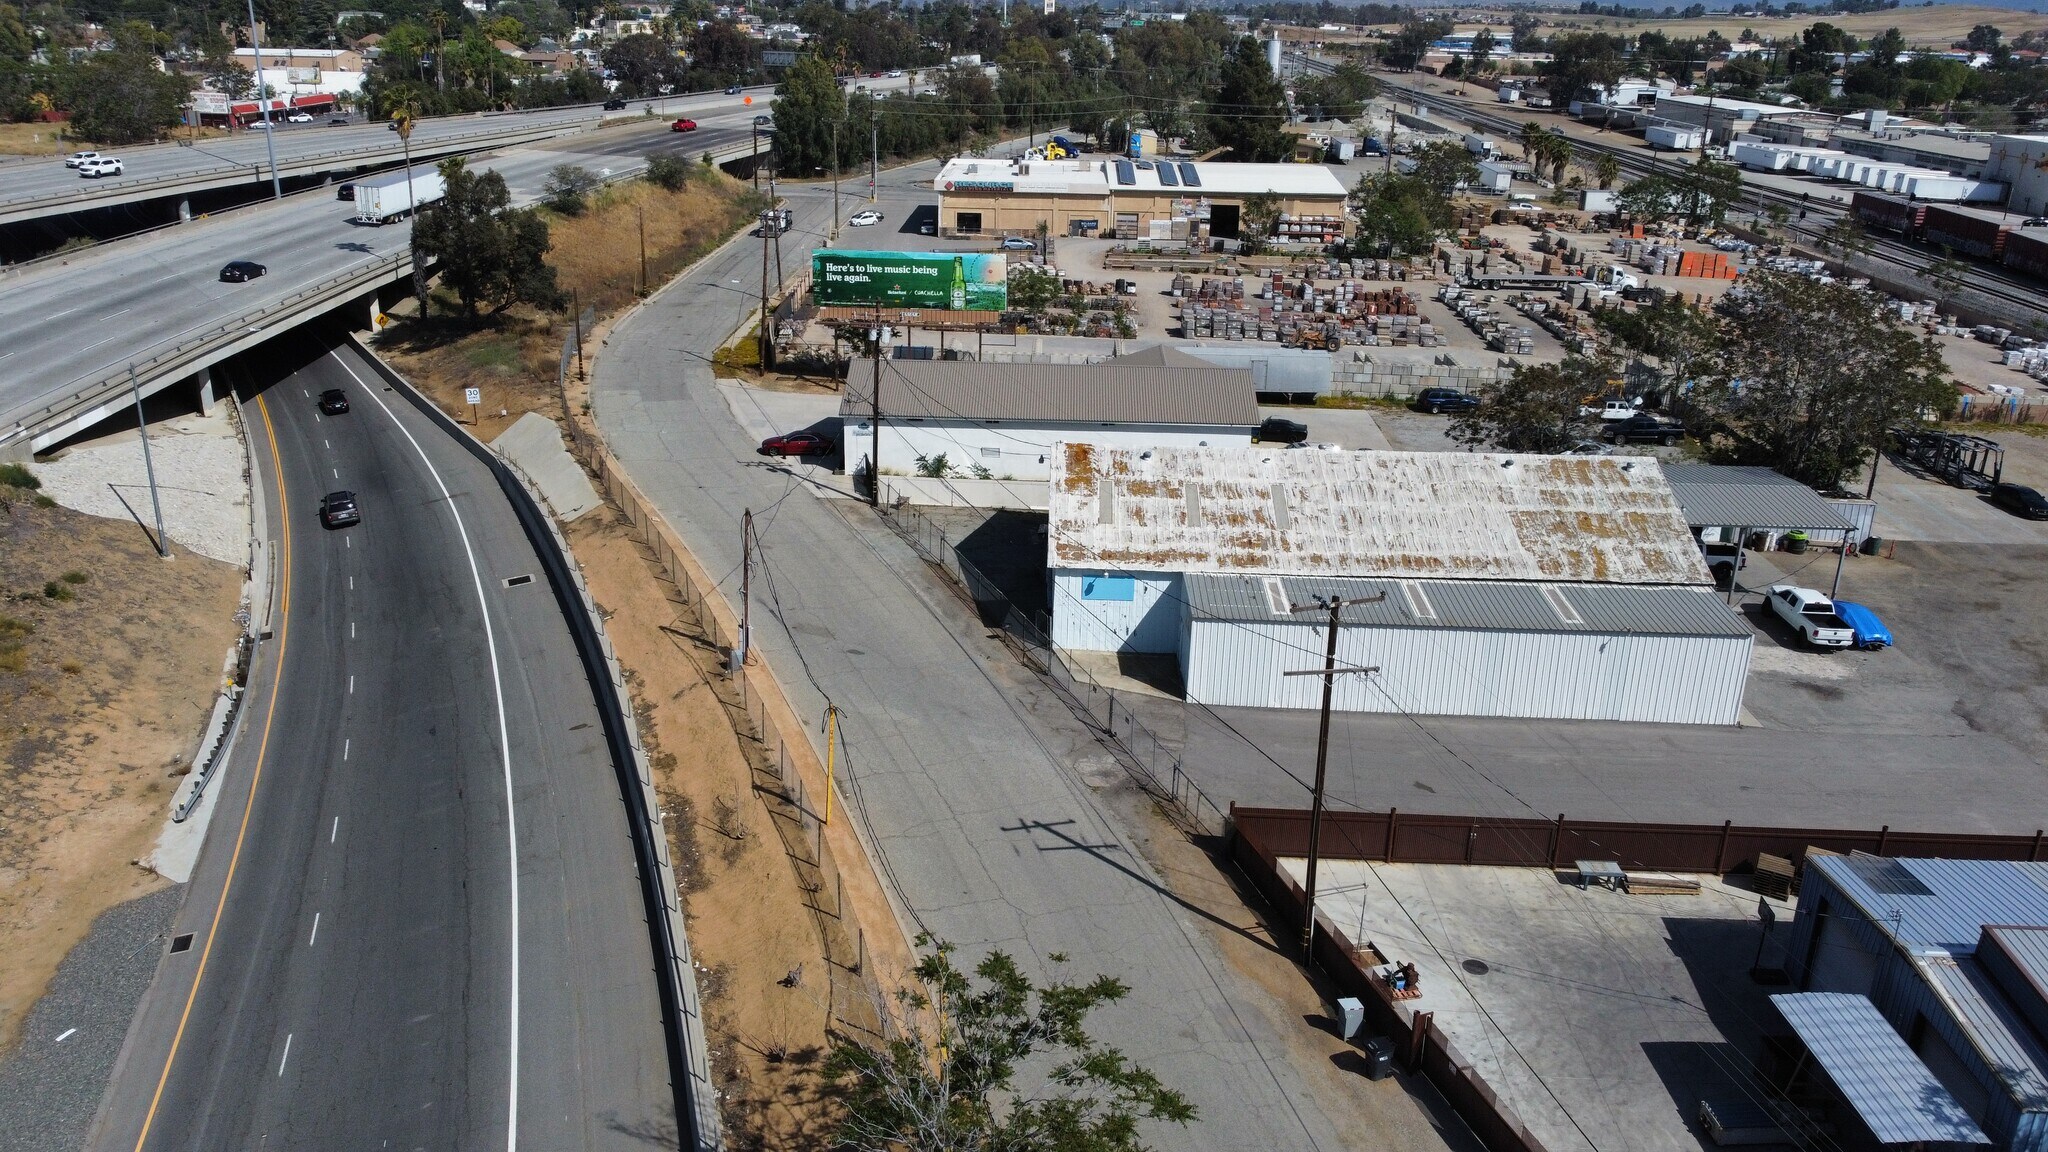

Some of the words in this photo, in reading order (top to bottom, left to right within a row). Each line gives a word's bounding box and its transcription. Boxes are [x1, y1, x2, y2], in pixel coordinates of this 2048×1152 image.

[826, 263, 855, 273] Here's
[856, 264, 866, 273] to
[866, 264, 883, 273] live
[884, 265, 911, 274] music
[912, 266, 938, 276] being
[826, 273, 842, 281] live
[844, 274, 871, 284] again.
